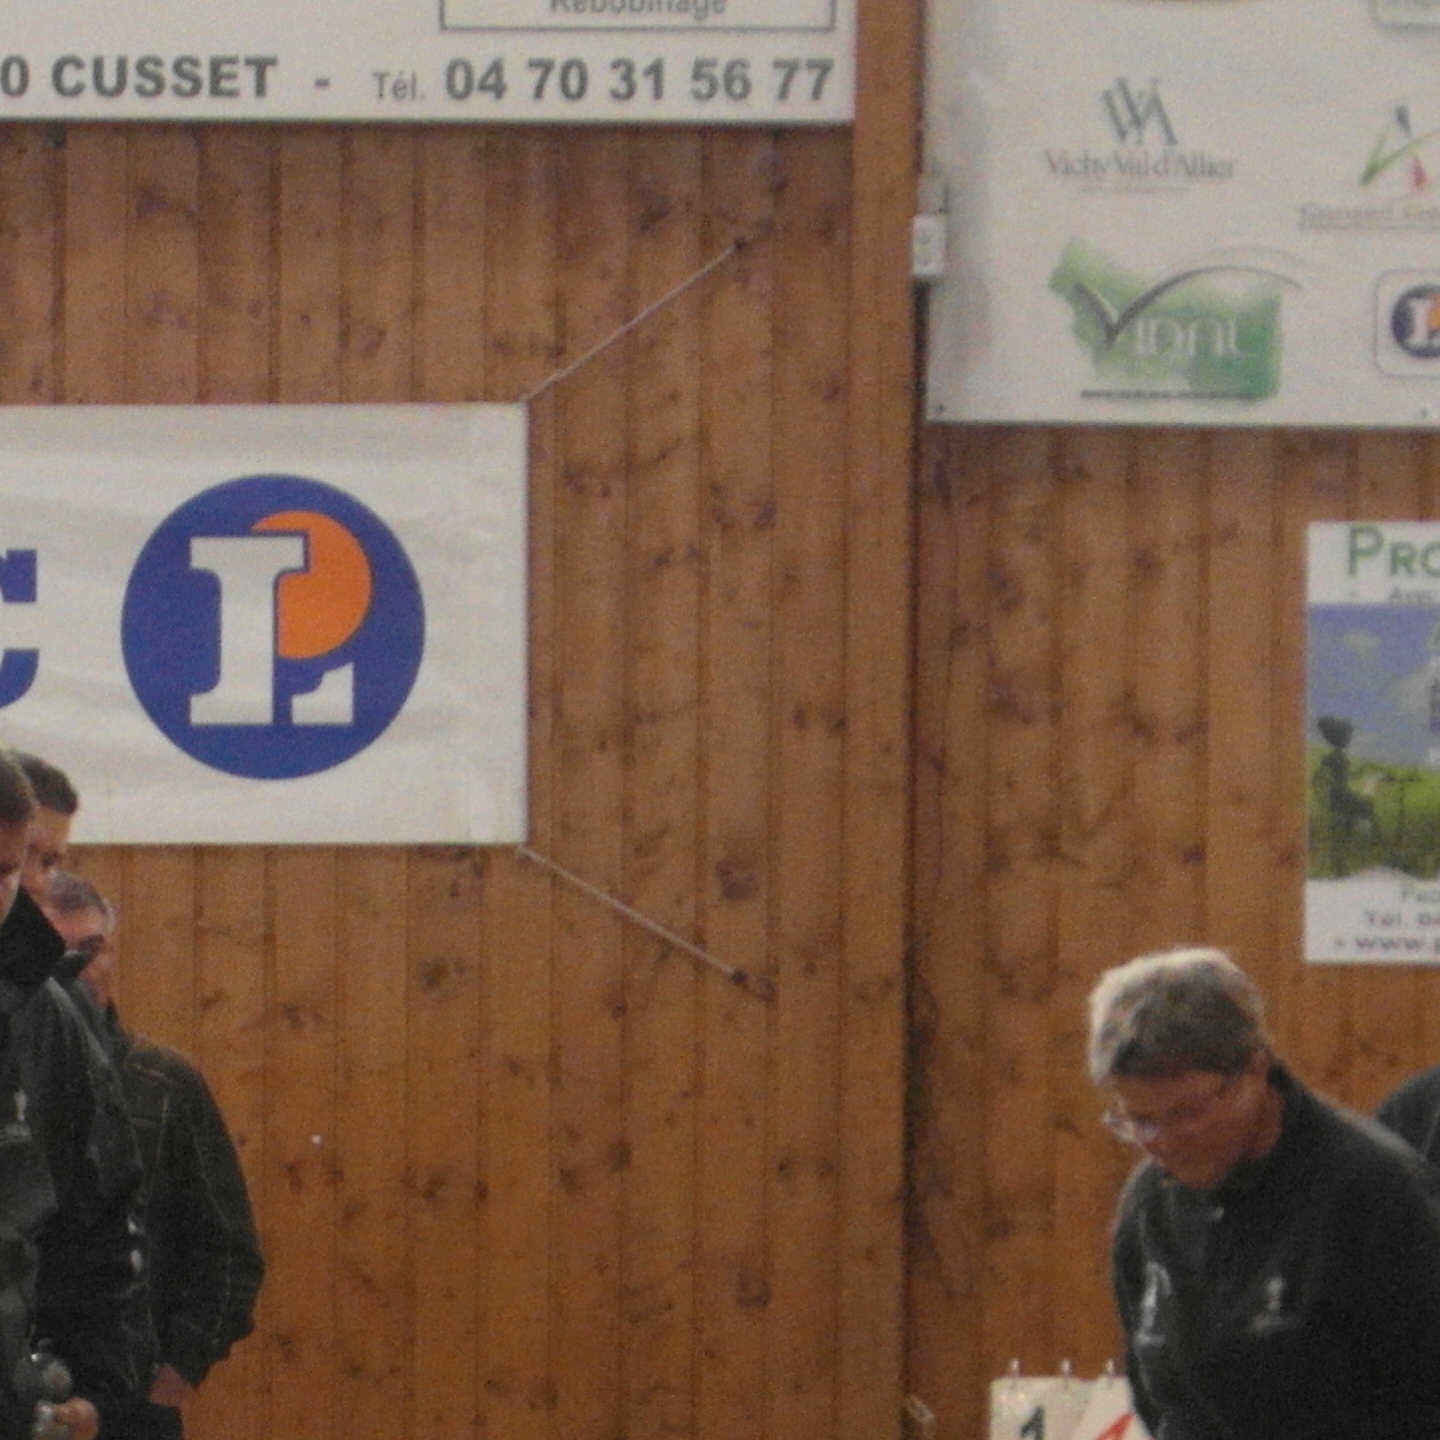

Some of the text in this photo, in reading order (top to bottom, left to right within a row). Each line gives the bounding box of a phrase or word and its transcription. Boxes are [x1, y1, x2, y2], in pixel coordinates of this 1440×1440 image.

[50, 55, 278, 98] CUSSET
[372, 72, 426, 101] Tél.
[445, 57, 508, 101] 04
[526, 57, 589, 101] 70
[609, 57, 666, 101] 31
[690, 57, 753, 101] 56
[772, 57, 834, 101] 77
[1044, 149, 1107, 180] Vichy
